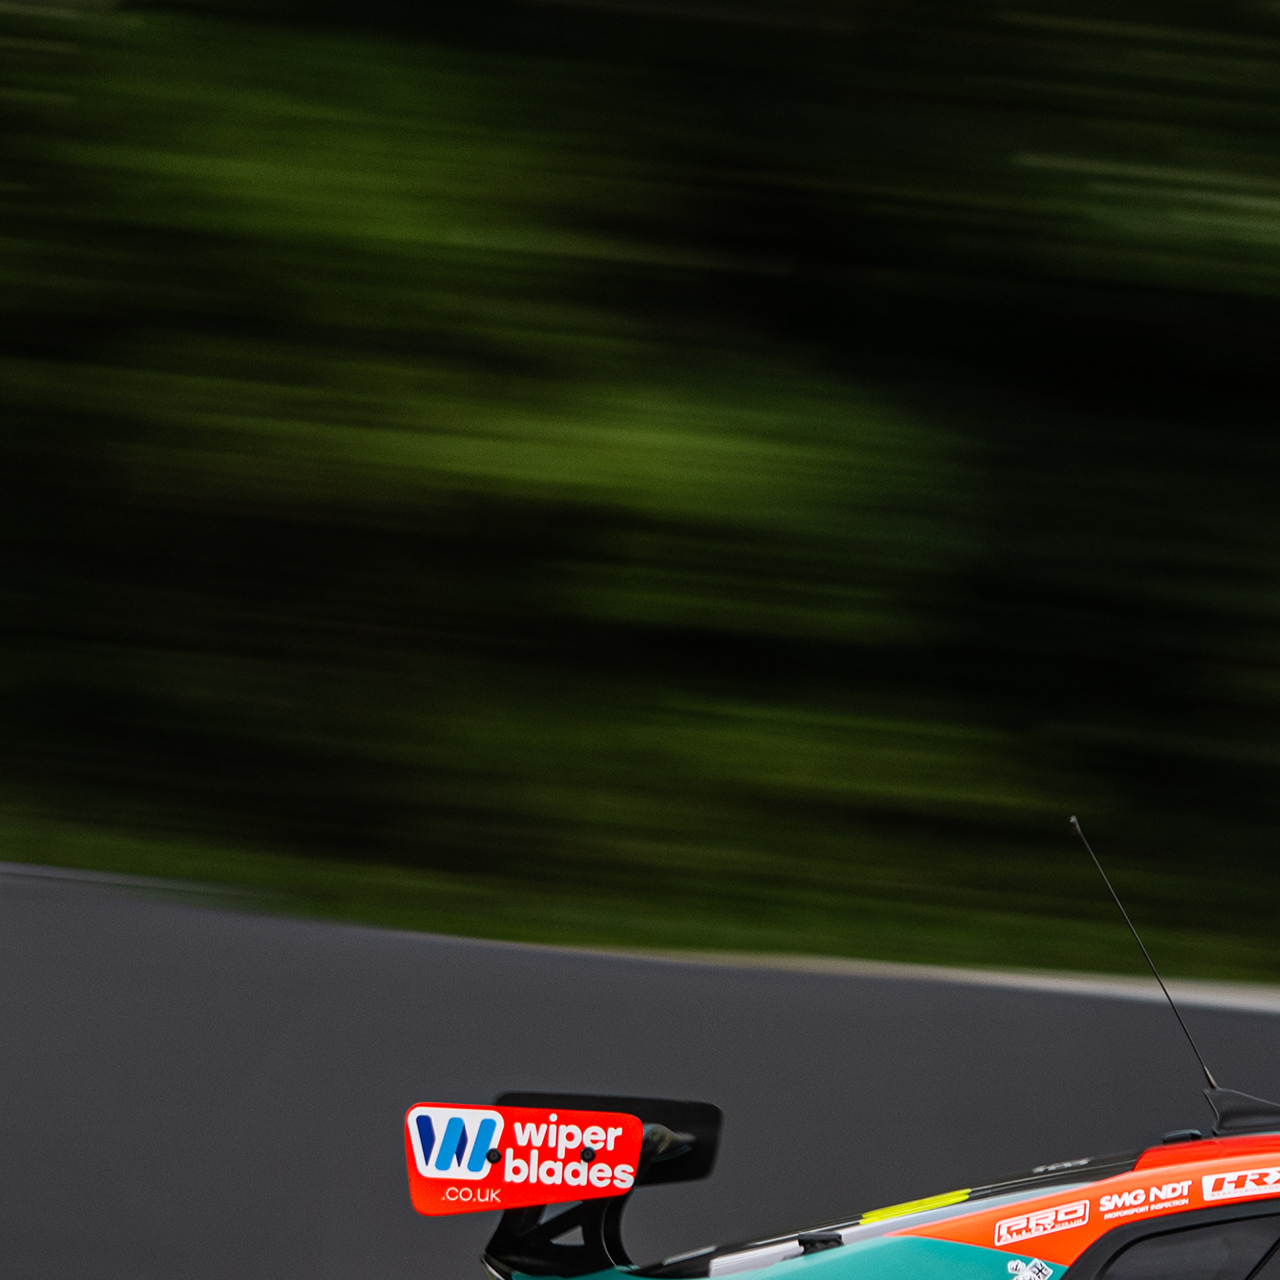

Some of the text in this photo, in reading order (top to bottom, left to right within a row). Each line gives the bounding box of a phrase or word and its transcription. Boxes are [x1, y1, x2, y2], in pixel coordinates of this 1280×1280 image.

[514, 1113, 622, 1159] wiper
[505, 1148, 635, 1189] blades
[1099, 1189, 1146, 1213] SMG
[1150, 1180, 1193, 1202] NDT
[1103, 1198, 1190, 1220] MOTORSPORT INSPECTION
[999, 1223, 1056, 1243] ALLOY
[1000, 1204, 1085, 1236] PRO
